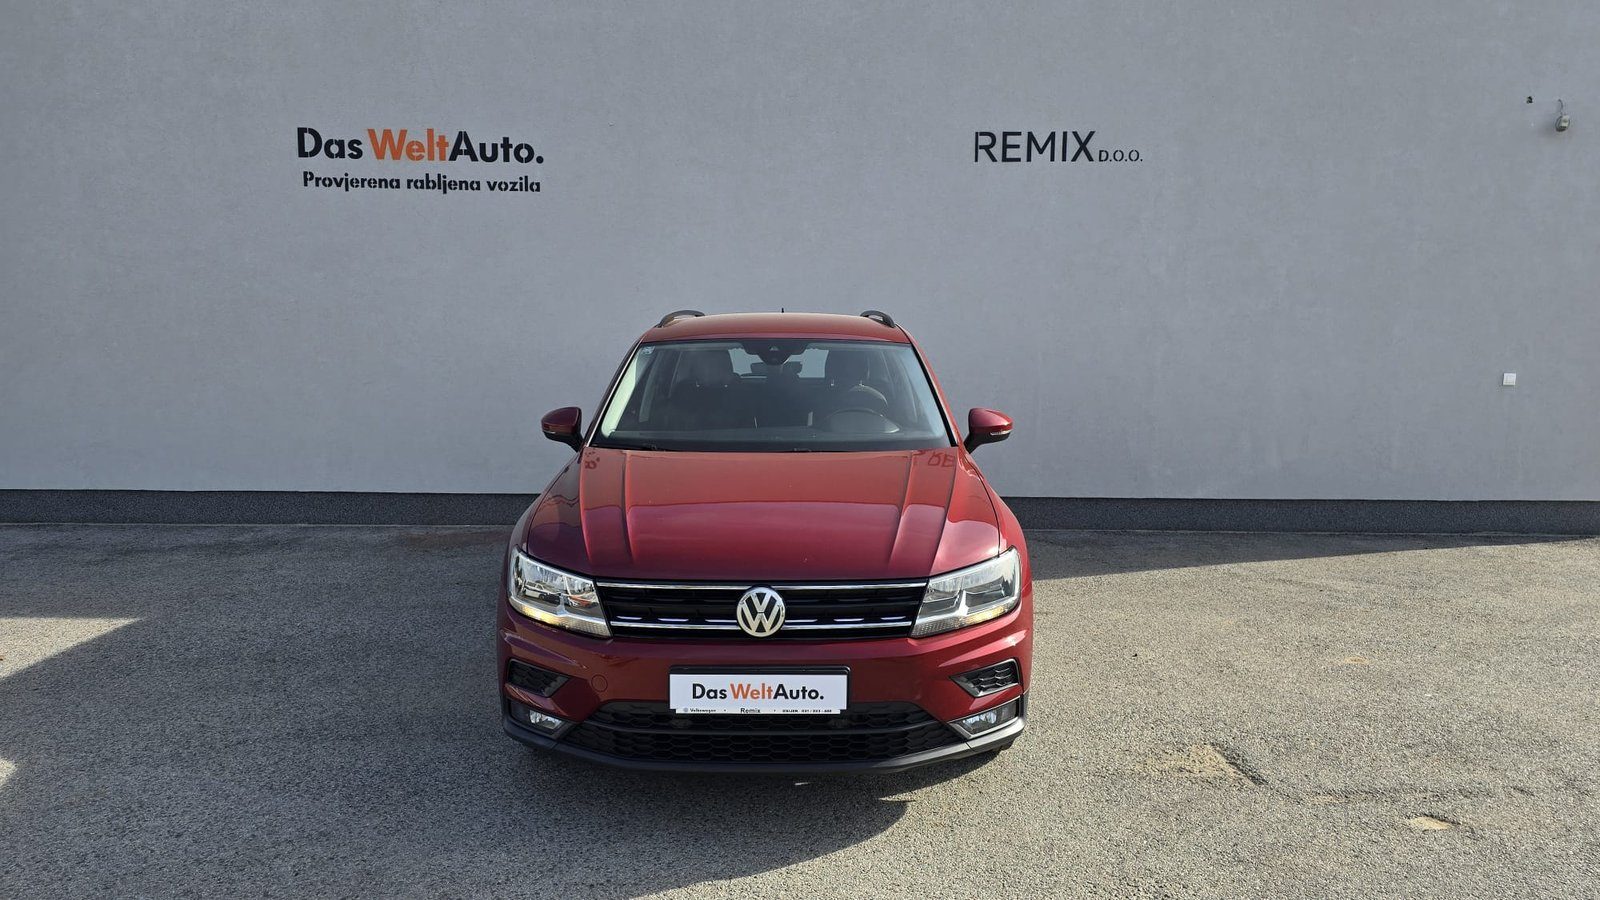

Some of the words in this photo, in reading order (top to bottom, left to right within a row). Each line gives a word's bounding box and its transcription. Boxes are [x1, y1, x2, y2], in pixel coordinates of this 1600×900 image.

[296, 127, 363, 159] Das
[367, 128, 544, 164] WeltAuto.
[974, 131, 1096, 162] REMIX
[1098, 149, 1143, 162] D.O.O.
[302, 171, 401, 192] Provjerena
[406, 173, 481, 194] rabljena
[486, 175, 541, 193] vozila
[692, 683, 728, 700] Das
[729, 682, 825, 700] WeltAuto.
